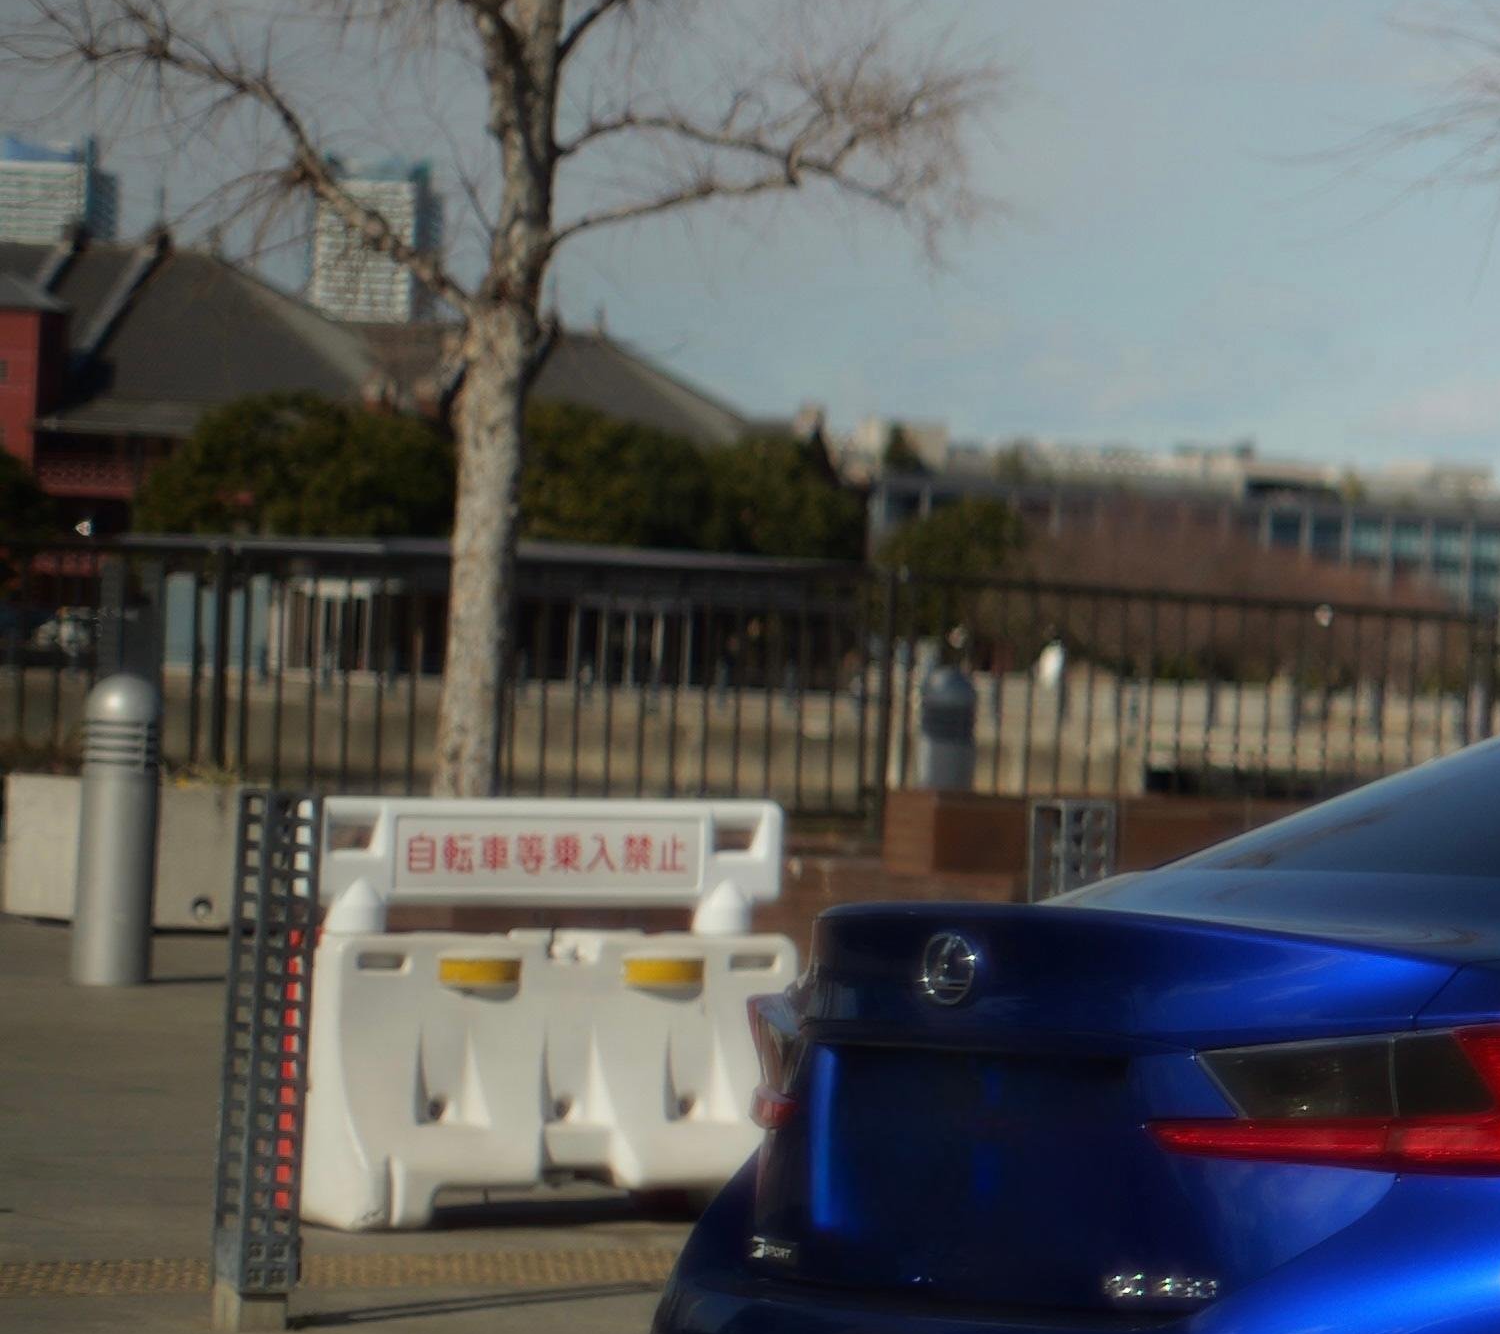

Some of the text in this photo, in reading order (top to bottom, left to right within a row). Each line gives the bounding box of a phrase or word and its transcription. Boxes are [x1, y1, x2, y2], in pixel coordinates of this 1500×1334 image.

[407, 831, 688, 876] 自転車等乗入禁止
